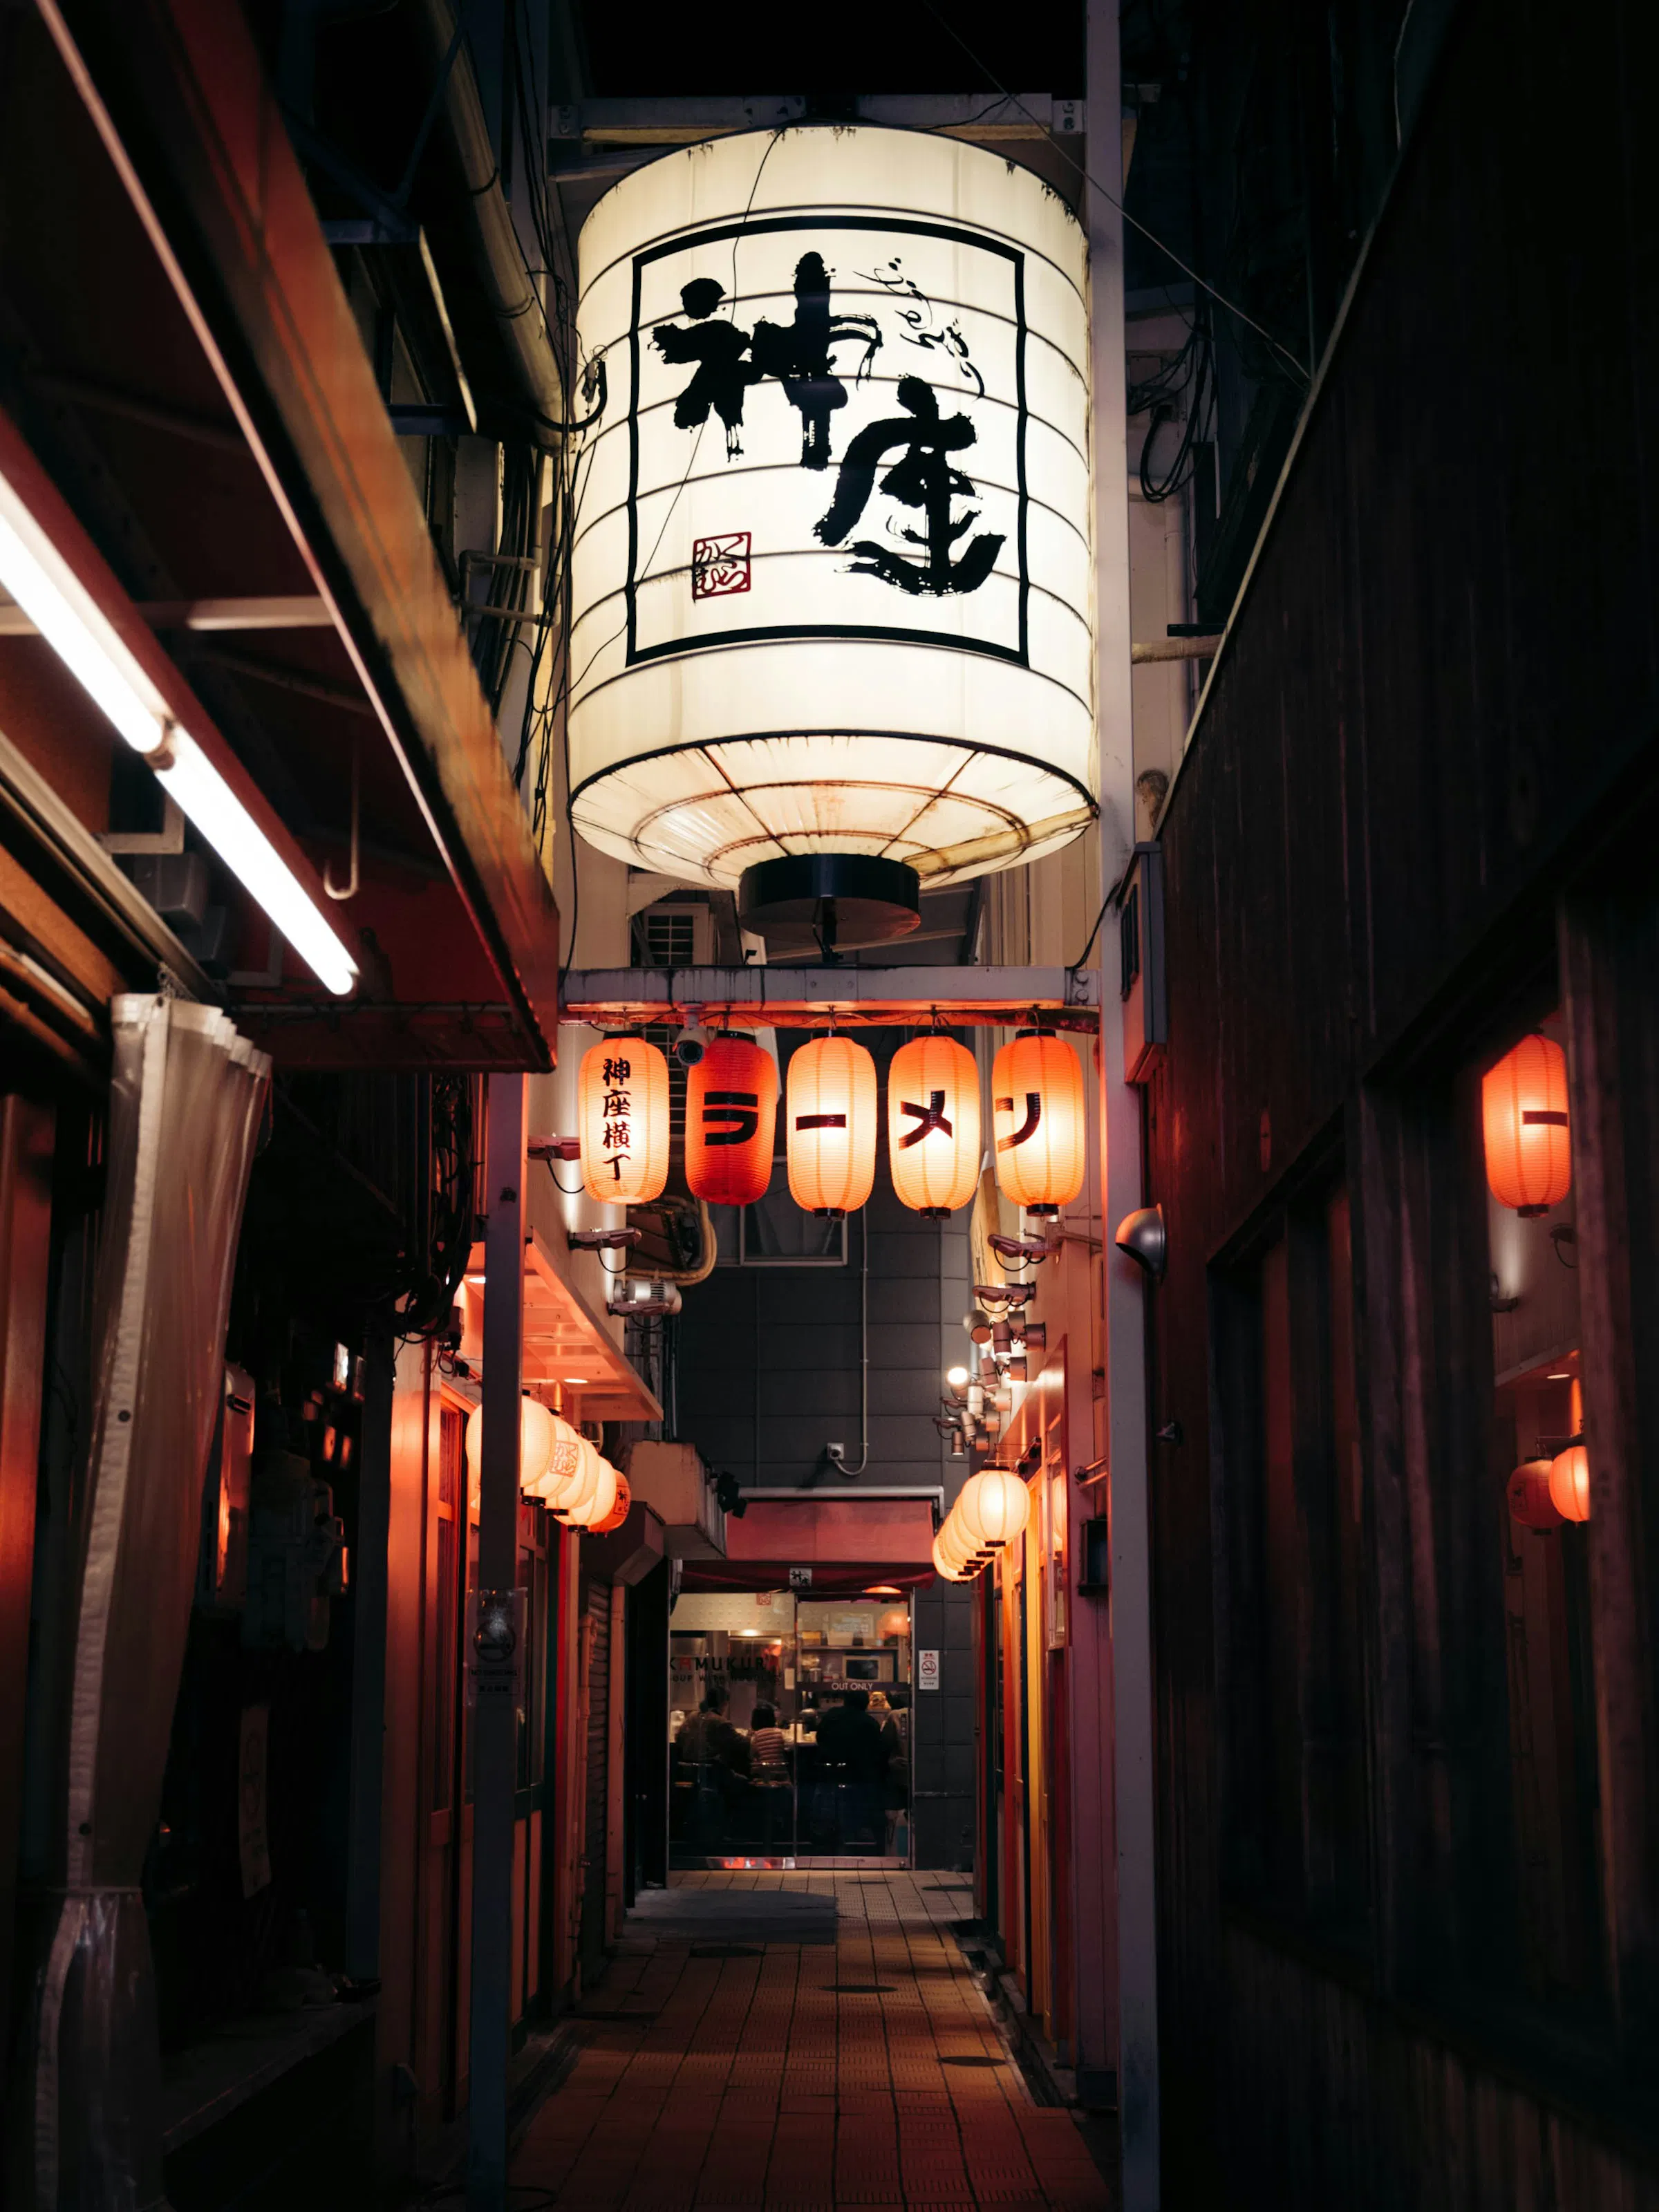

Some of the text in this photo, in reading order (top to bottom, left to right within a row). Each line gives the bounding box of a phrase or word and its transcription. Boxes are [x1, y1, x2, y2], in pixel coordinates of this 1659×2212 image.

[602, 1057, 632, 1181] 神座横丁
[832, 1682, 873, 1691] OUT ONLY
